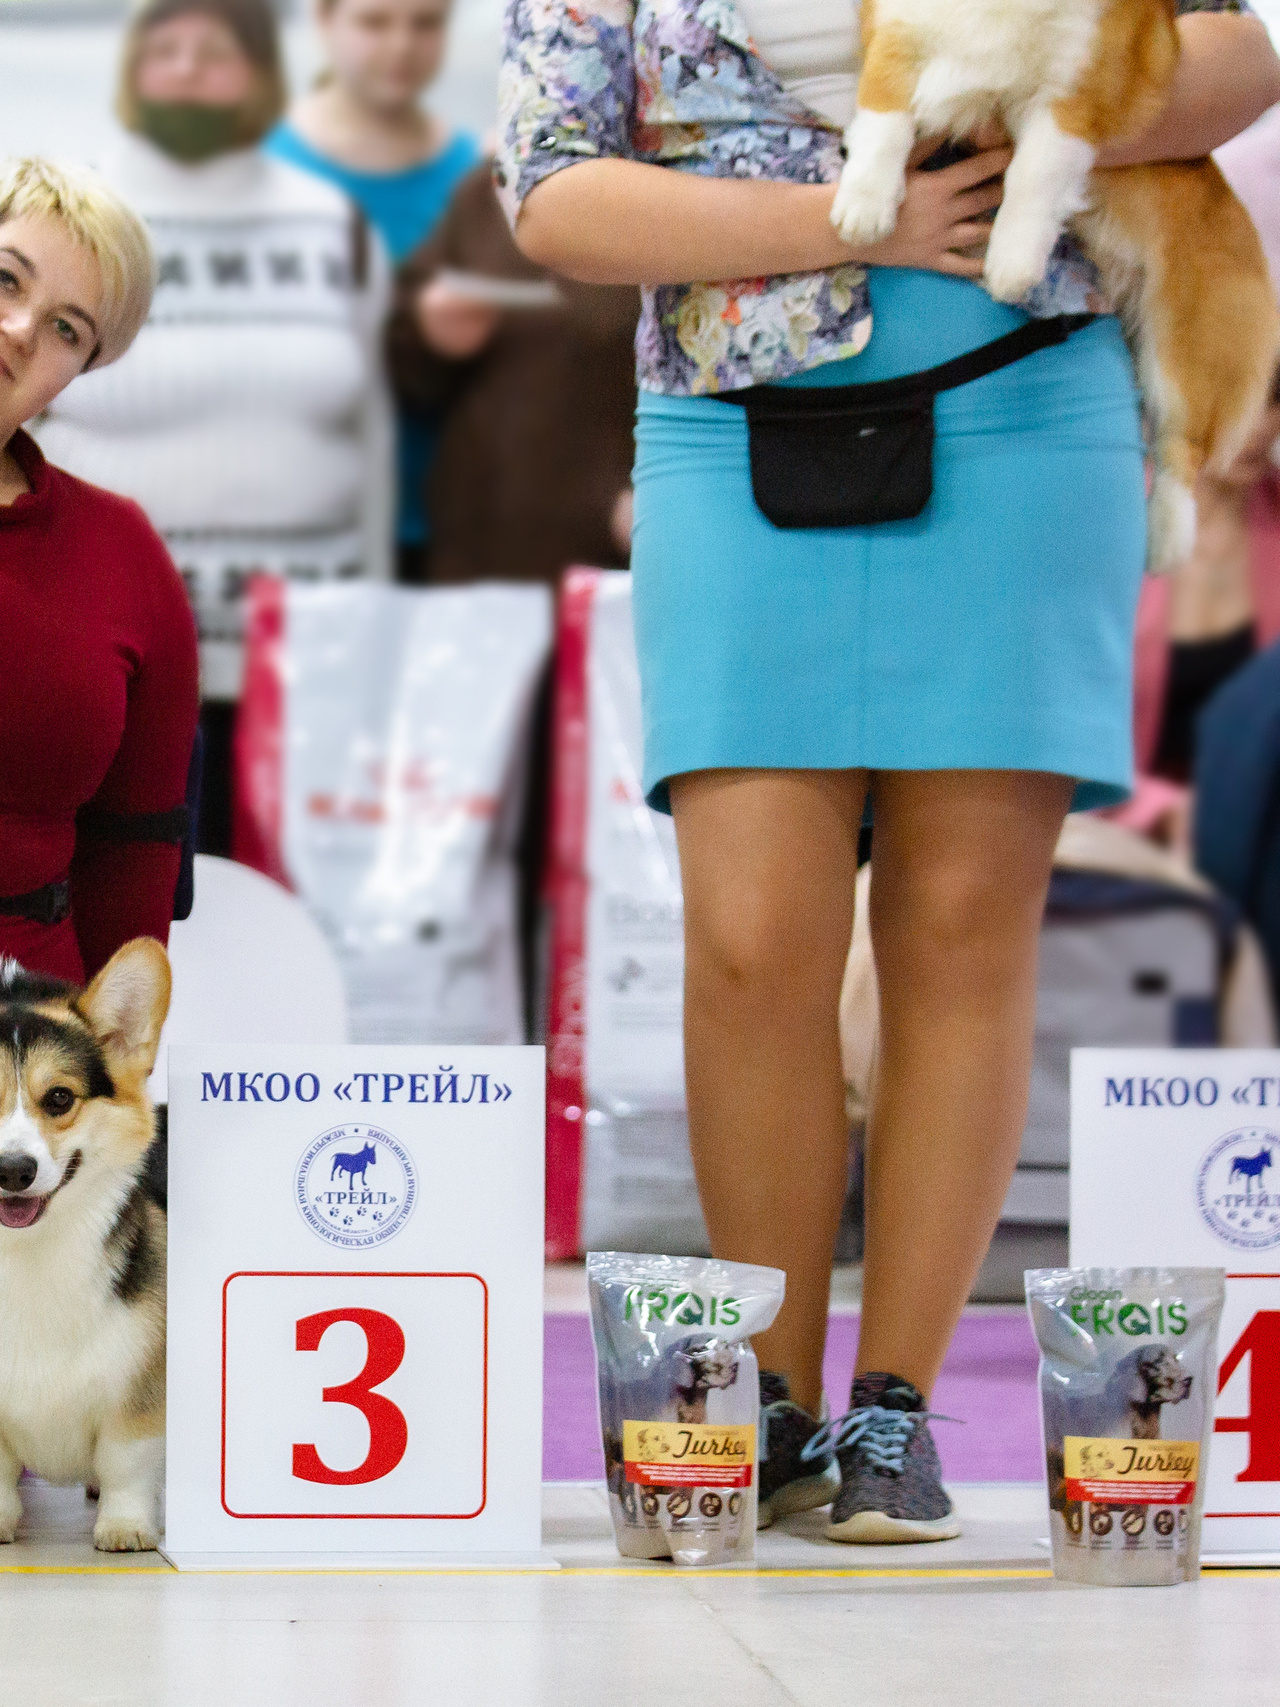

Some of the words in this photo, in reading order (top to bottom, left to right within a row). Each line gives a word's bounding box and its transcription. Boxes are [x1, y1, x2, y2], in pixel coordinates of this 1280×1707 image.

[200, 1071, 321, 1102] МКОО
[333, 1064, 513, 1104] «ТРЕЙЛ»
[1104, 1076, 1219, 1107] МКОО
[1231, 1076, 1280, 1107] «Т
[314, 1187, 398, 1205] «ТРЕЙЛ»
[1070, 1302, 1188, 1336] FRAIS
[293, 1308, 407, 1485] 3
[1117, 1446, 1195, 1478] Turkey
